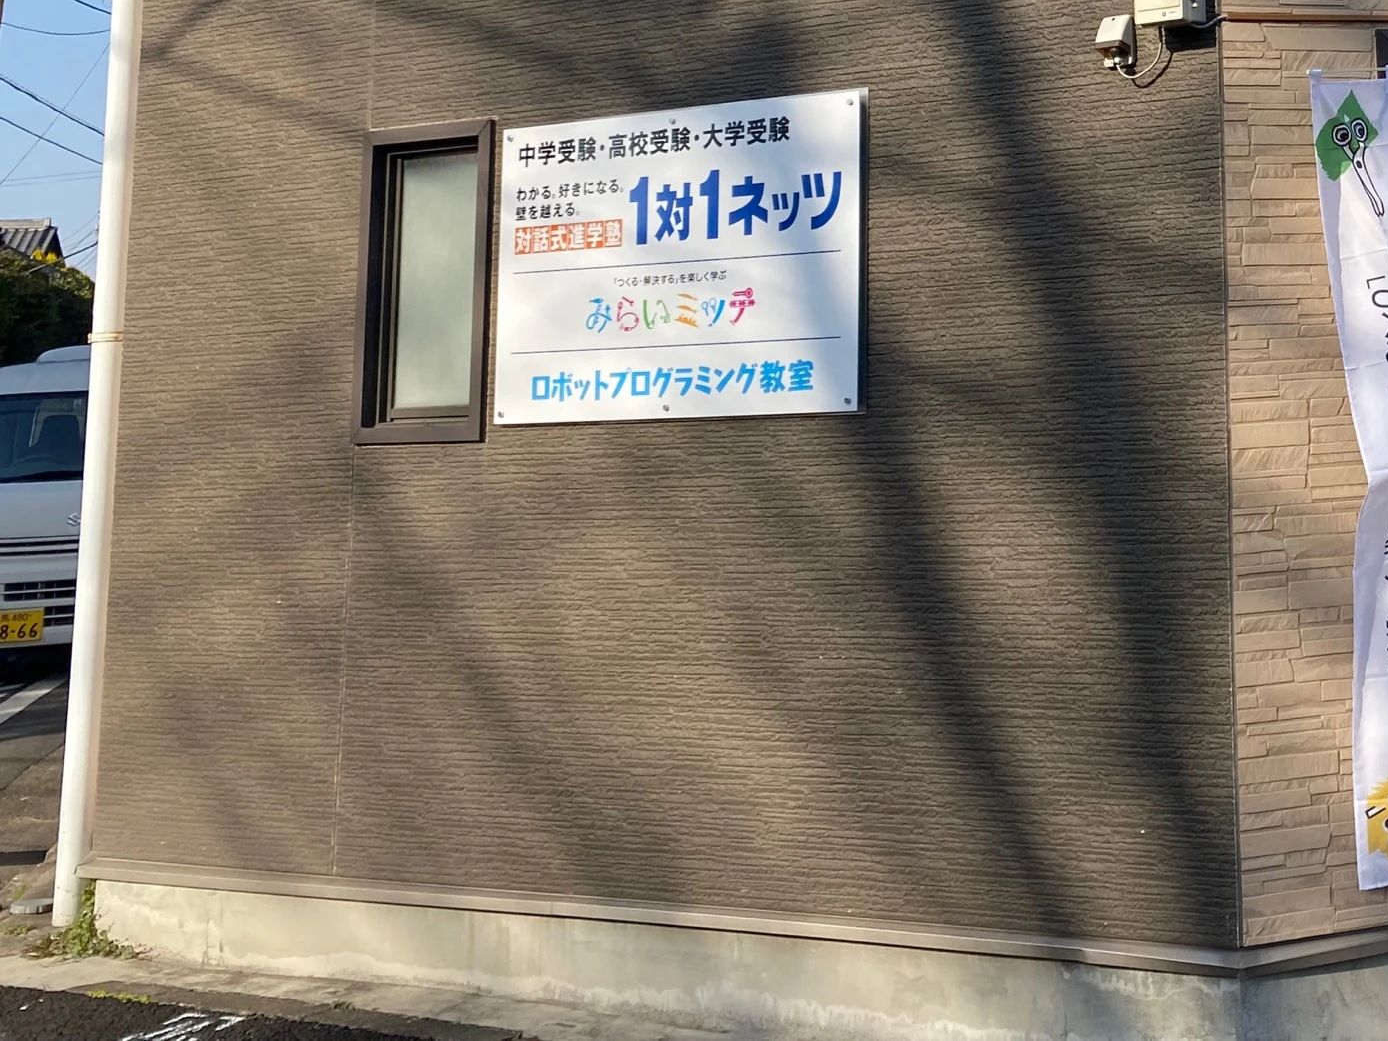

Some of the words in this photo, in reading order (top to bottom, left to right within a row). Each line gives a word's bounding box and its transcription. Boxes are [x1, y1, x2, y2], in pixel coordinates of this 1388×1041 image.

[518, 116, 790, 168] 中学受験・高校受験・大学受験
[515, 179, 625, 202] わかる。好きになる。
[629, 169, 843, 246] 1対1ネッツ
[514, 220, 623, 255] 対話式進学塾
[531, 359, 814, 402] ロボットプログラミング教室
